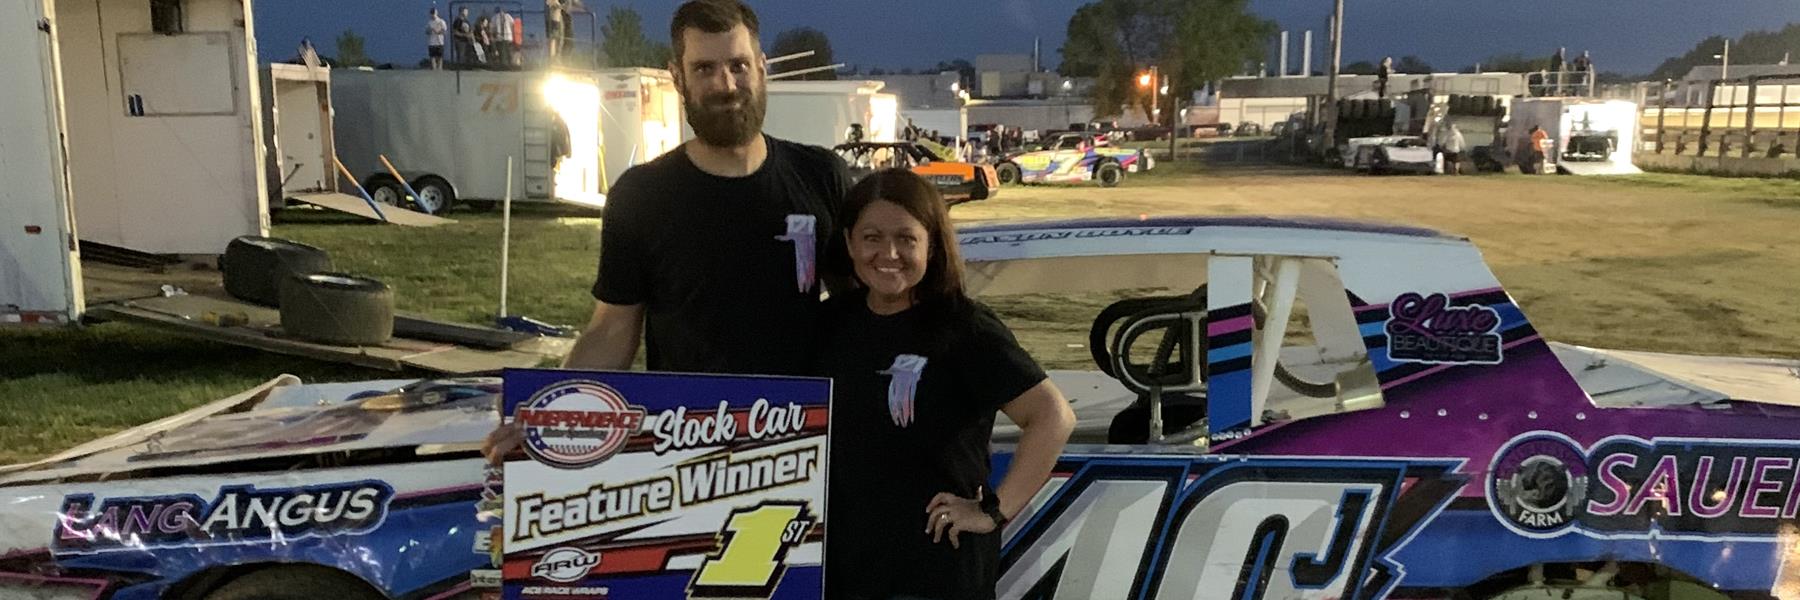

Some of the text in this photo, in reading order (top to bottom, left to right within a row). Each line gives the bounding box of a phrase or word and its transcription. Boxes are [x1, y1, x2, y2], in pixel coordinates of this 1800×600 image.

[480, 82, 519, 113] 73
[1388, 292, 1498, 337] Luxe
[652, 398, 806, 453] Stock Car
[61, 488, 379, 540] LANG ANGUS
[513, 446, 818, 541] Feature Winner
[1519, 509, 1563, 527] FARM
[534, 555, 598, 573] ARW
